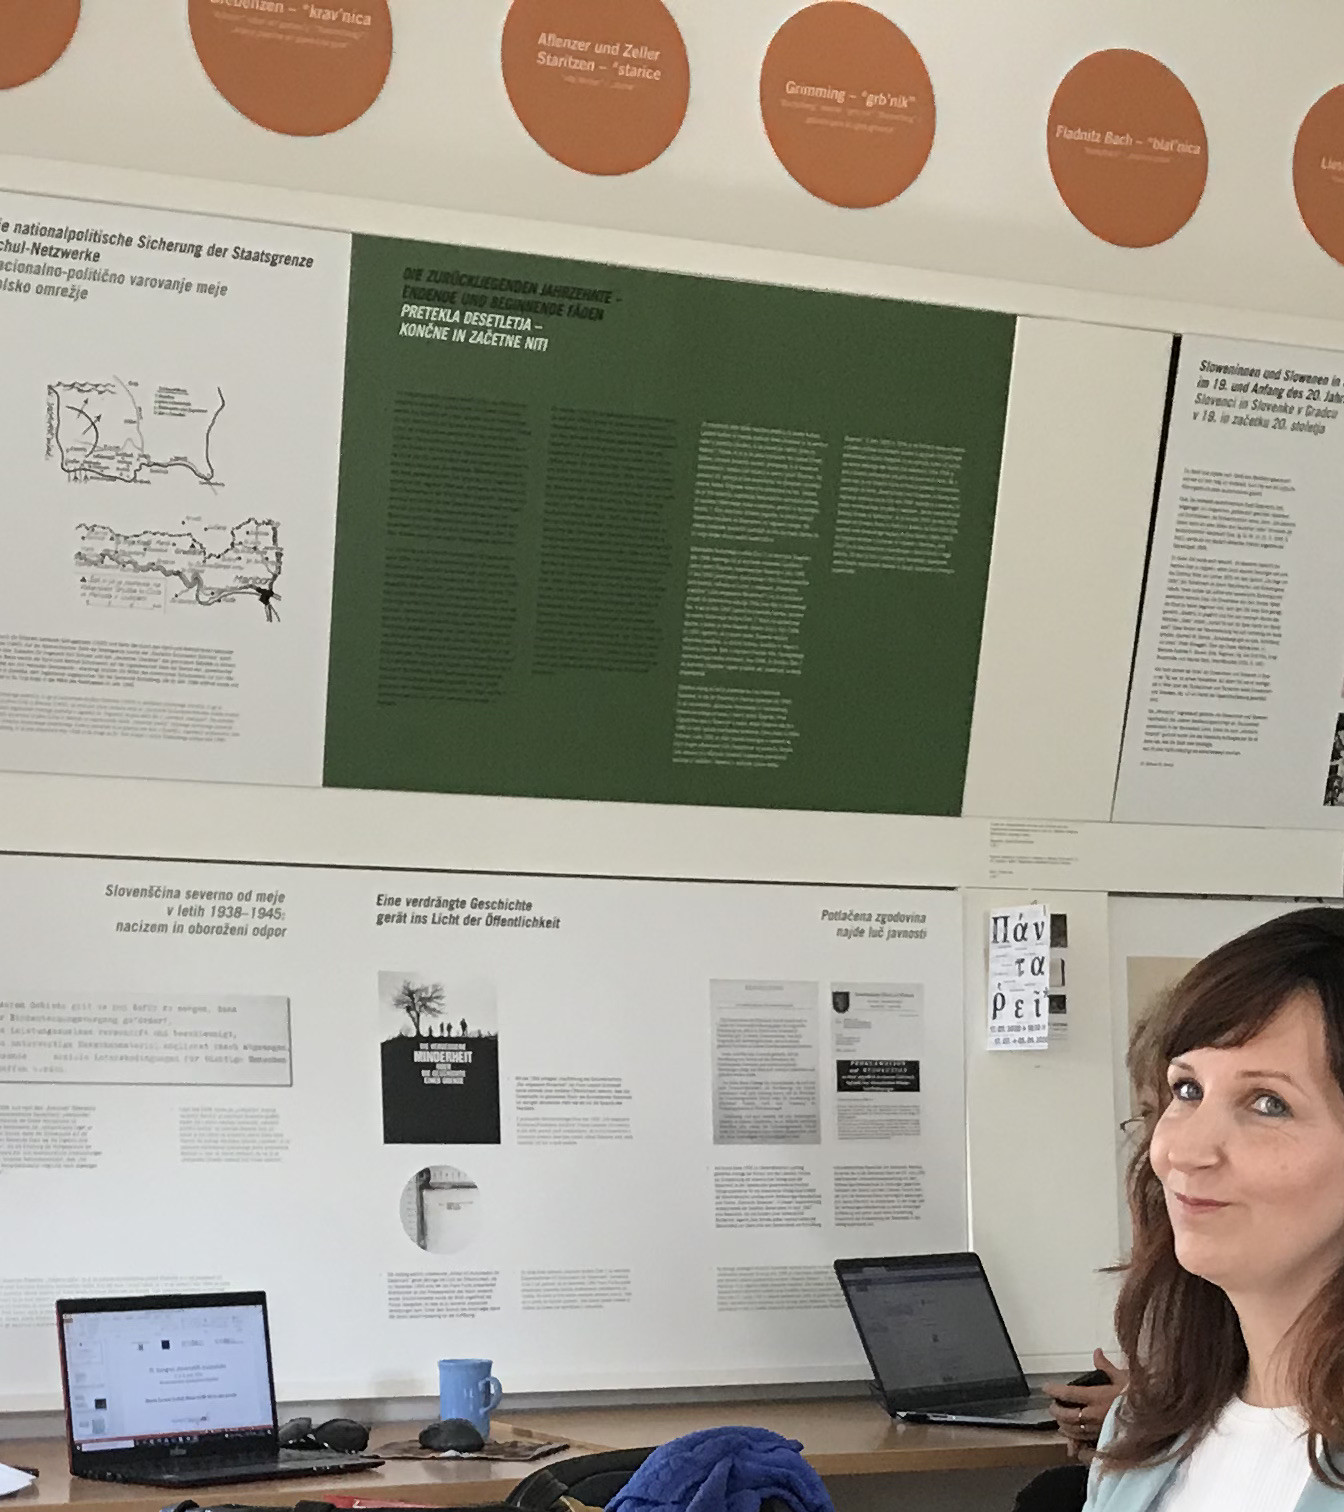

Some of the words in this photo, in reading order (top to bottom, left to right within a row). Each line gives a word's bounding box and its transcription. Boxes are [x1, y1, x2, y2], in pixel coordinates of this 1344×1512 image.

[594, 42, 620, 57] und
[622, 43, 661, 60] Zeller
[13, 220, 133, 248] nationalpolitische
[136, 234, 204, 258] Sicherung
[207, 243, 229, 258] der
[231, 246, 314, 269] Staatsgrenze
[35, 283, 89, 302] omrežje
[129, 274, 193, 294] varovanje
[196, 280, 229, 298] meje
[400, 304, 460, 323] PRETEKLA
[463, 311, 532, 331] DESETLETJA
[399, 322, 450, 342] KONČNE
[452, 328, 467, 342] IN
[468, 328, 521, 349] ZAČETNE
[524, 336, 550, 352] NITI
[1199, 360, 1261, 378] Sloweninnen
[1262, 369, 1283, 380] und
[1283, 369, 1330, 386] Slowenen
[1330, 375, 1341, 387] in
[1196, 375, 1210, 389] im
[1230, 381, 1251, 393] und
[1250, 382, 1285, 400] Anfang
[1285, 386, 1304, 399] des
[104, 884, 182, 900] Slovenščina
[184, 888, 234, 901] severno
[236, 890, 253, 903] od
[255, 890, 286, 906] meje
[375, 893, 402, 908] Eine
[405, 896, 467, 912] verdrängte
[469, 897, 534, 912] Geschichte
[166, 906, 174, 917] v
[176, 904, 206, 918] letih
[375, 911, 407, 926] gerät
[409, 912, 428, 925] ins
[430, 913, 460, 926] Licht
[462, 914, 483, 927] der
[484, 912, 562, 929] Öffentlichkeit
[820, 909, 873, 922] Potlačena
[874, 911, 927, 925] zgodovina
[115, 919, 169, 934] nacizem
[172, 921, 185, 934] in
[187, 922, 249, 936] oboroženi
[251, 924, 288, 940] odpor
[885, 927, 929, 941] javnosti
[413, 1050, 473, 1064] MINDERHEIT
